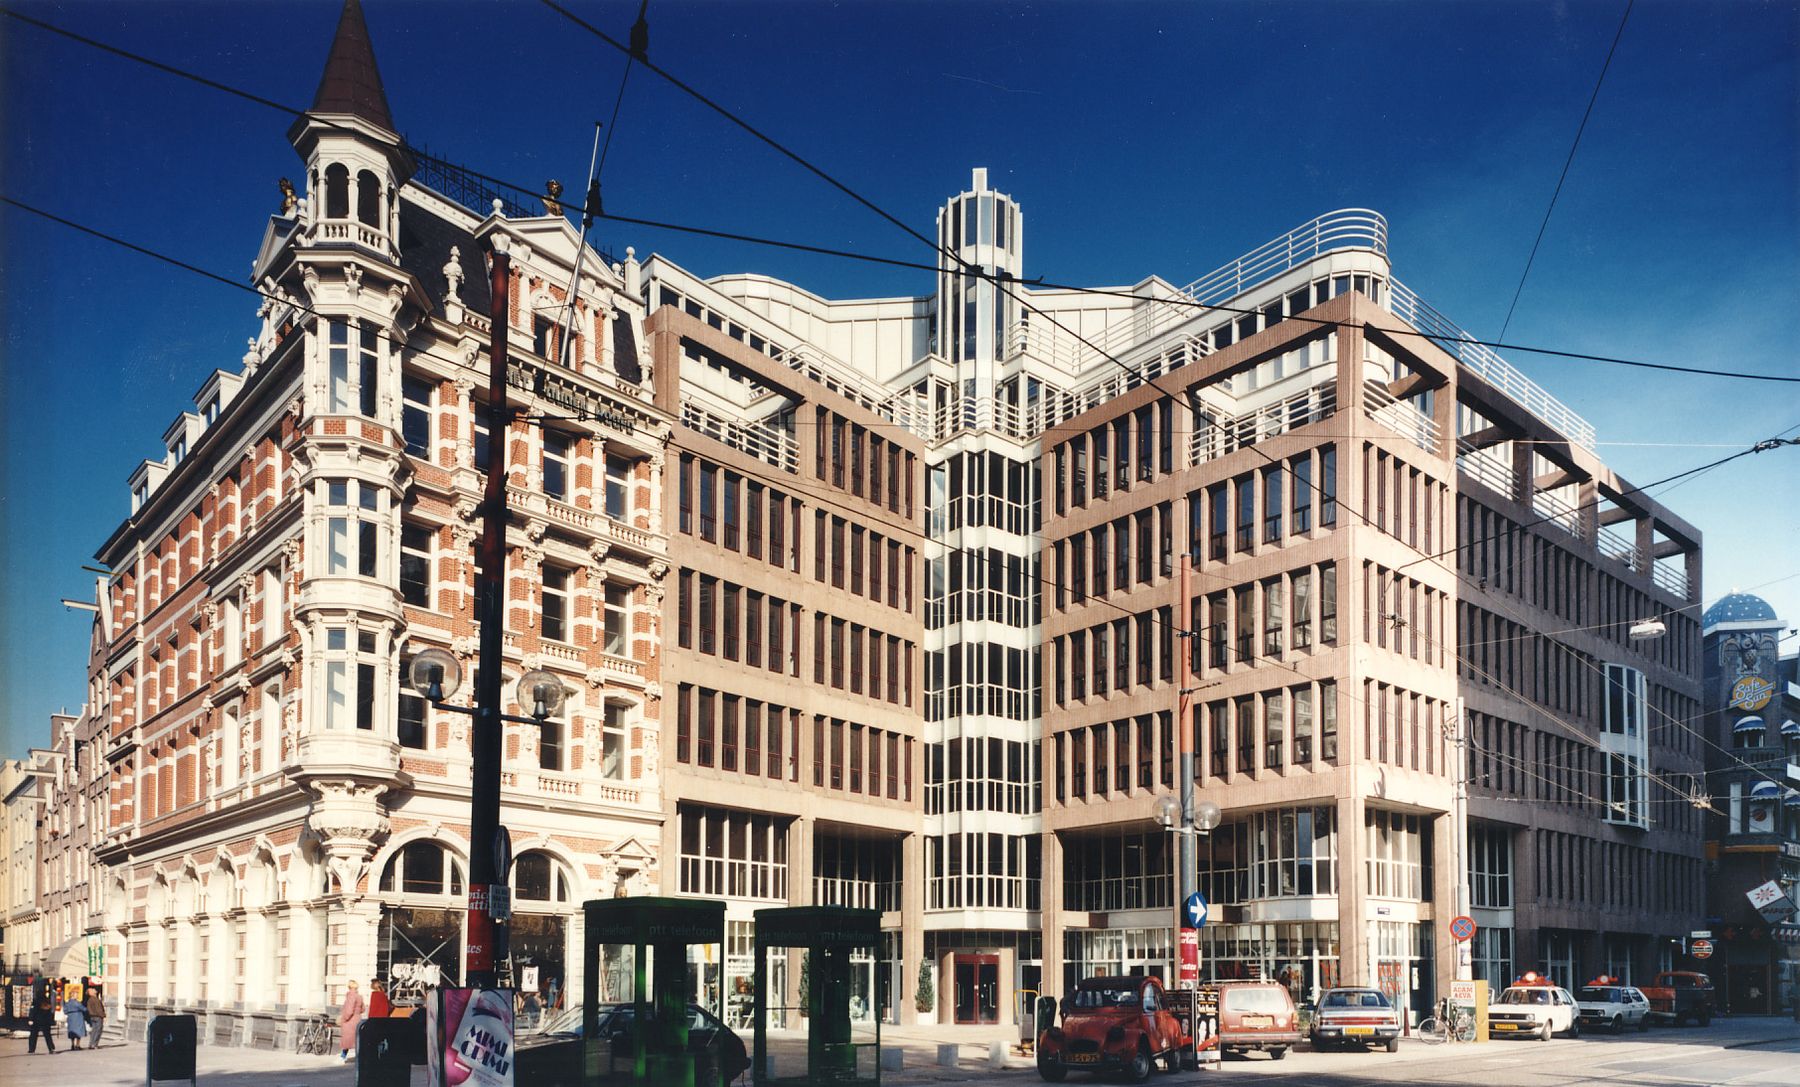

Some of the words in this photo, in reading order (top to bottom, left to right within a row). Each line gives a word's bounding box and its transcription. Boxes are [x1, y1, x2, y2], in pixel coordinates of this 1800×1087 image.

[1736, 677, 1761, 700] Safe
[1745, 692, 1768, 710] Sun
[649, 925, 667, 938] ptt
[466, 1024, 508, 1058] MIMI
[461, 1040, 509, 1076] CRIMI
